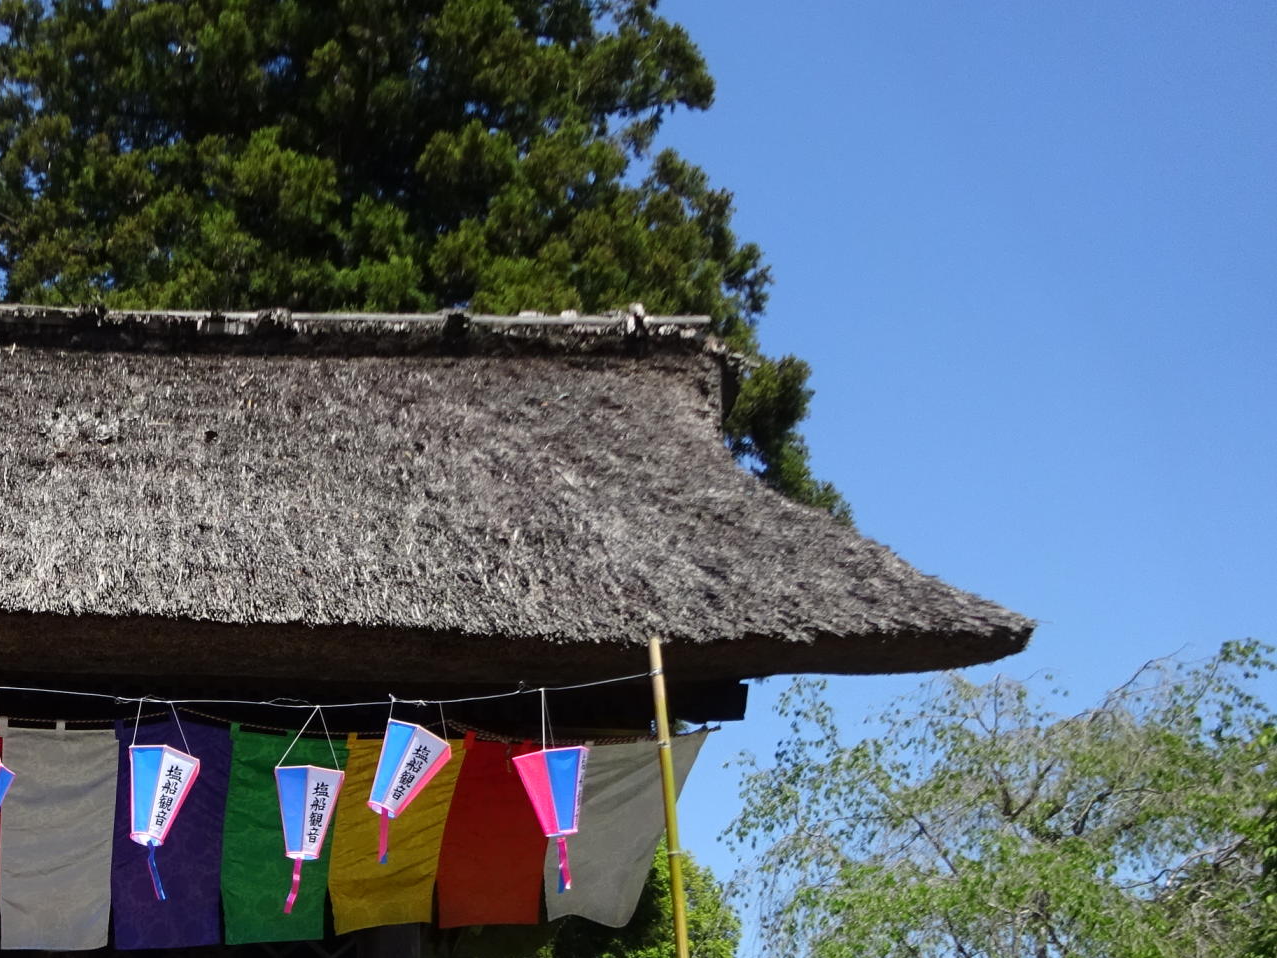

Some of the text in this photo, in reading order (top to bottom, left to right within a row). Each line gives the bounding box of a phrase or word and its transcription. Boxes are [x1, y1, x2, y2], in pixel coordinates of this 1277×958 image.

[155, 764, 184, 826] 塩船観音
[392, 744, 431, 800] 塩船観音
[307, 781, 330, 843] 塩船観音
